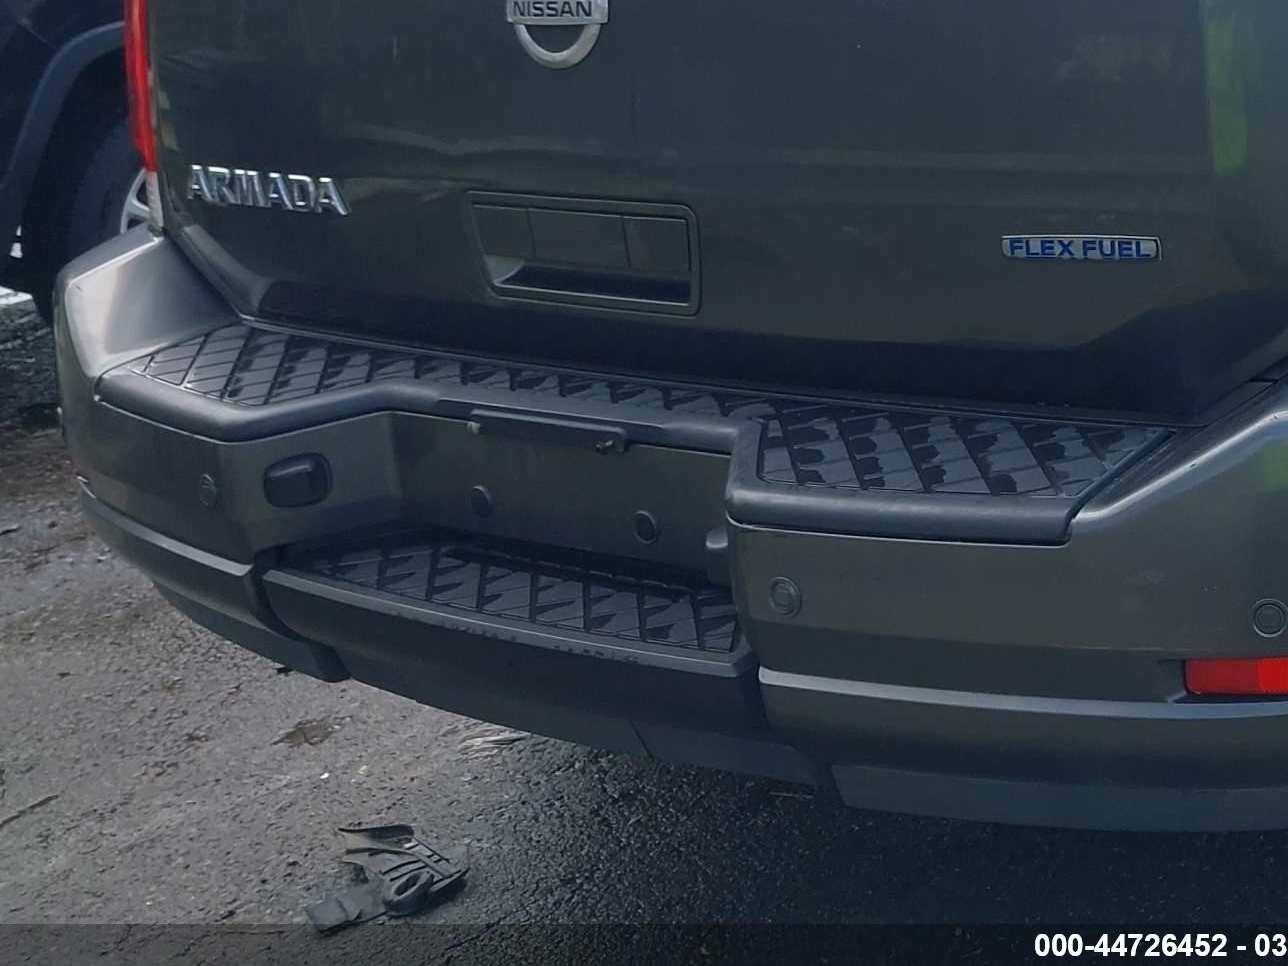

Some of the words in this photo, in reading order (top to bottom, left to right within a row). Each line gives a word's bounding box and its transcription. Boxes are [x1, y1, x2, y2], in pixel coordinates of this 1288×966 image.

[513, 1, 592, 17] NISSAN
[187, 164, 350, 216] ARMADA
[1008, 238, 1075, 258] FLEX
[1081, 239, 1152, 258] FUEL
